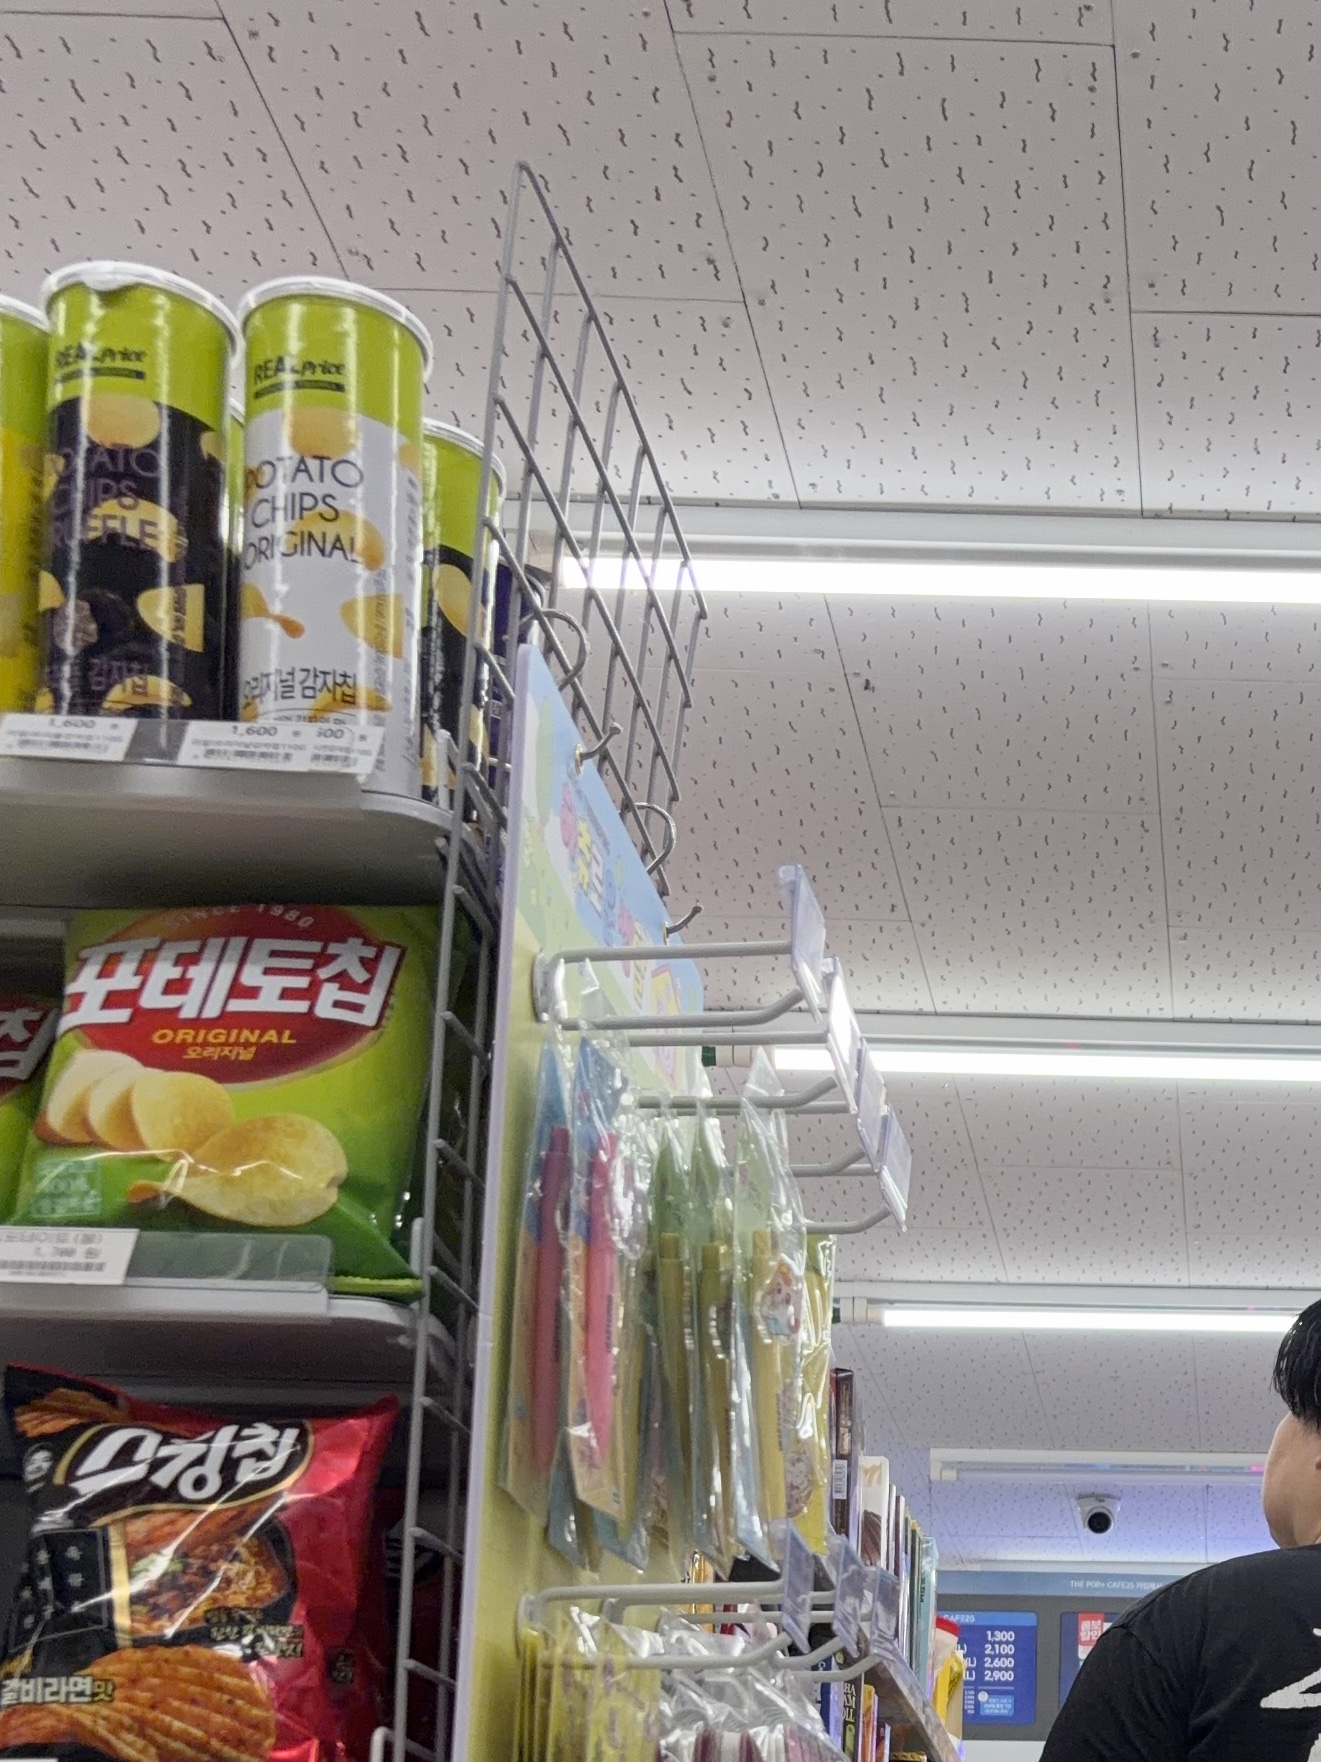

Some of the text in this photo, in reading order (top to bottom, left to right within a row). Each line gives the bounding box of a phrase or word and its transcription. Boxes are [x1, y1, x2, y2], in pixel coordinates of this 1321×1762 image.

[252, 492, 340, 529] CHIPS
[244, 529, 364, 571] ORIGINAL
[151, 1028, 297, 1046] ORIGINAL
[183, 1045, 256, 1062] 오리지널
[986, 1630, 1016, 1643] 1,300
[984, 1644, 1015, 1656] 2,100
[984, 1657, 1015, 1670] 2,600
[984, 1671, 1015, 1683] 2,900
